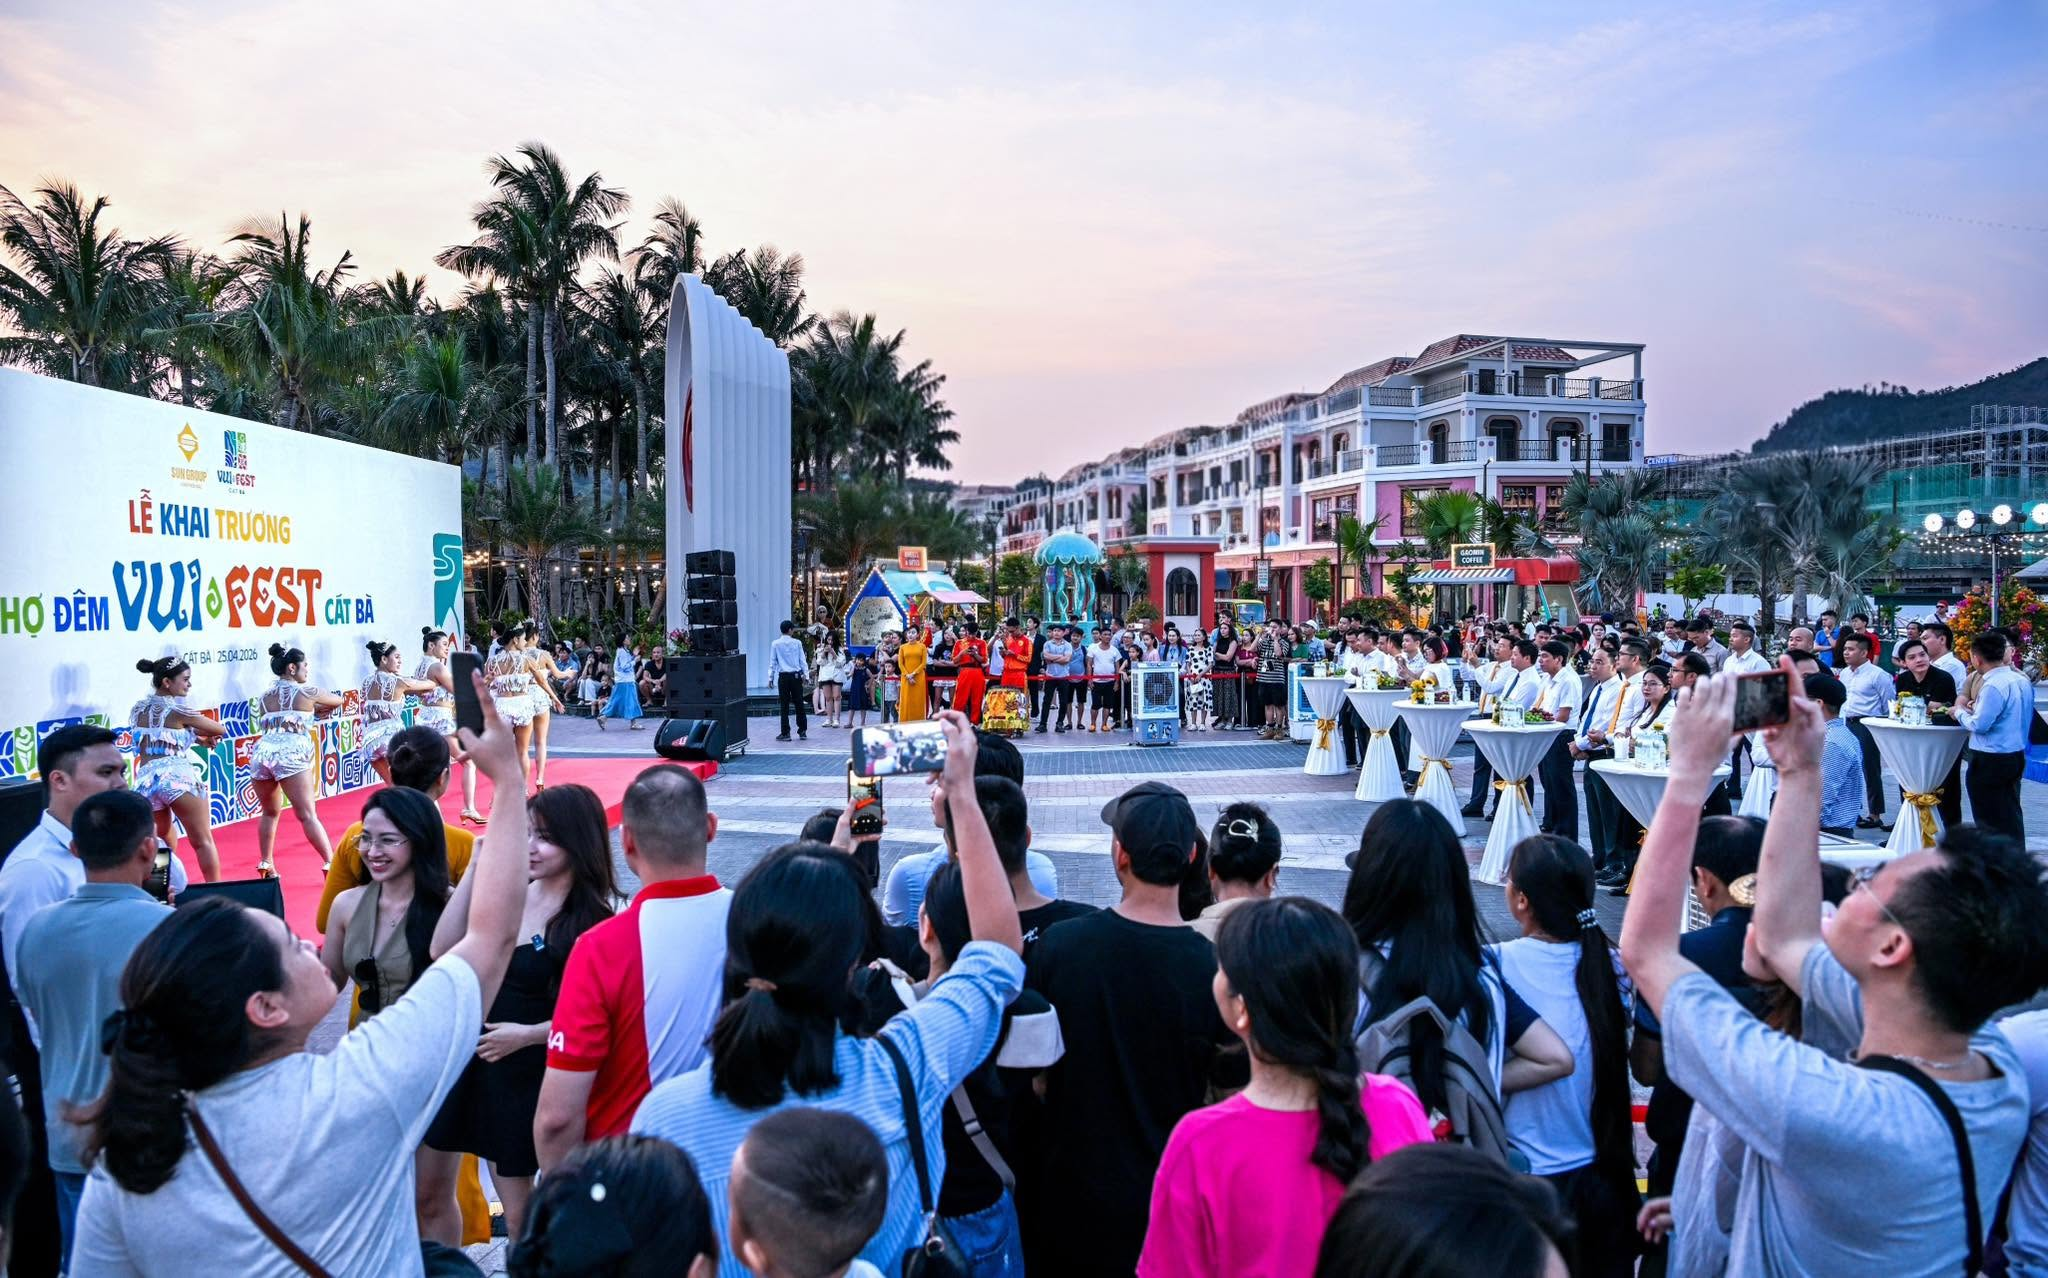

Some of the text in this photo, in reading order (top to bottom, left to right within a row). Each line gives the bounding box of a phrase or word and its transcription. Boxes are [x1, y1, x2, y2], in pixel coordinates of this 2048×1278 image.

[171, 466, 208, 482] SUN GROUP
[217, 469, 256, 487] VUI FEST
[129, 488, 292, 544] LỄ KHAI TRƯƠNG
[0, 558, 374, 638] HỢ ĐÊM VUI FEST CÁT BÀ
[217, 648, 258, 663] 25.04.2026
